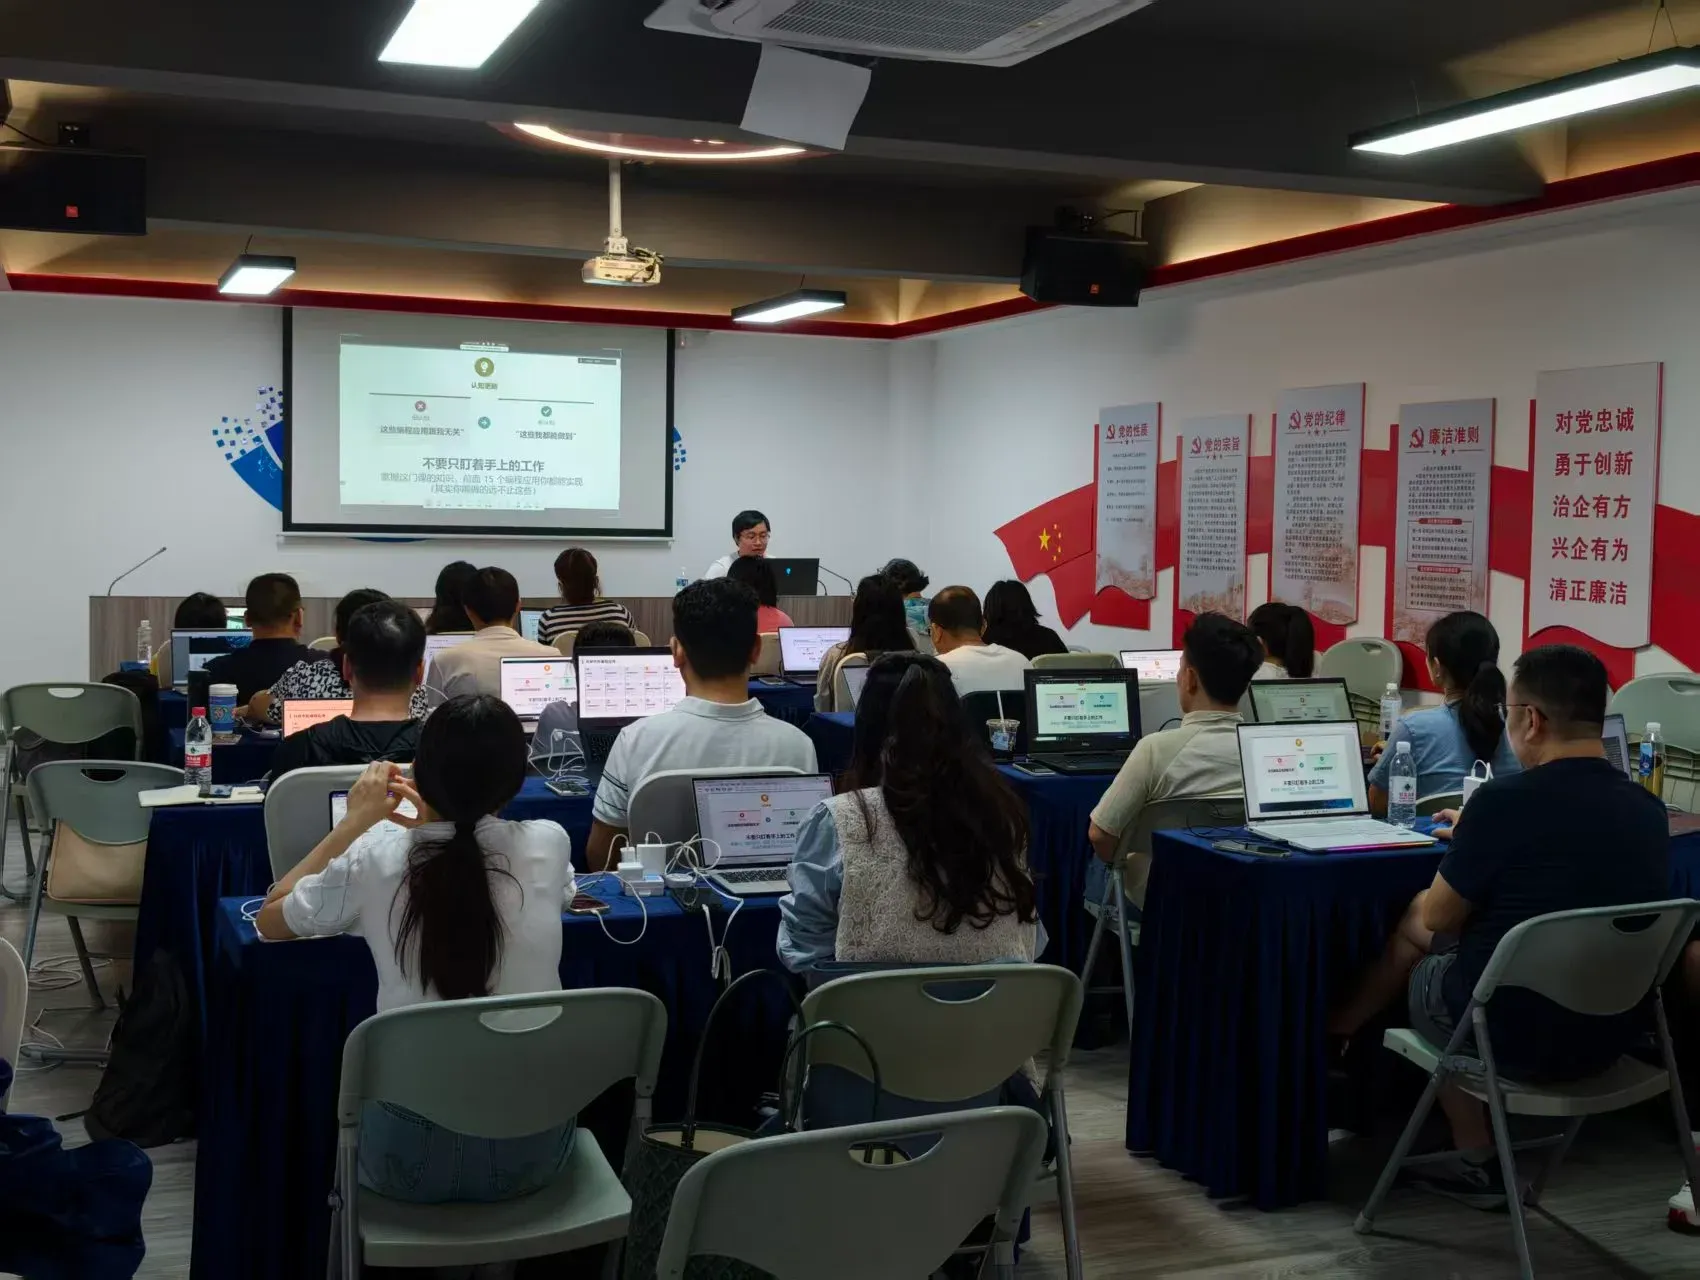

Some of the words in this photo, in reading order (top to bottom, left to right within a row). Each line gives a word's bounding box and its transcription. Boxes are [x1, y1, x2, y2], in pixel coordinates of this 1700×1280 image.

[1304, 410, 1346, 427] 党的纪律
[1555, 407, 1634, 434] 对党忠诚
[1118, 424, 1149, 438] 党的性质
[1428, 426, 1480, 445] 廉洁准则
[1204, 437, 1241, 454] 党的宗旨
[422, 457, 545, 472] 不要只盯着手上的工作
[1554, 450, 1633, 477] 勇于创新
[485, 475, 494, 483] 15
[1553, 494, 1631, 519] 治企有方
[1552, 537, 1629, 562] 兴企有为
[1549, 577, 1628, 605] 清正廉洁
